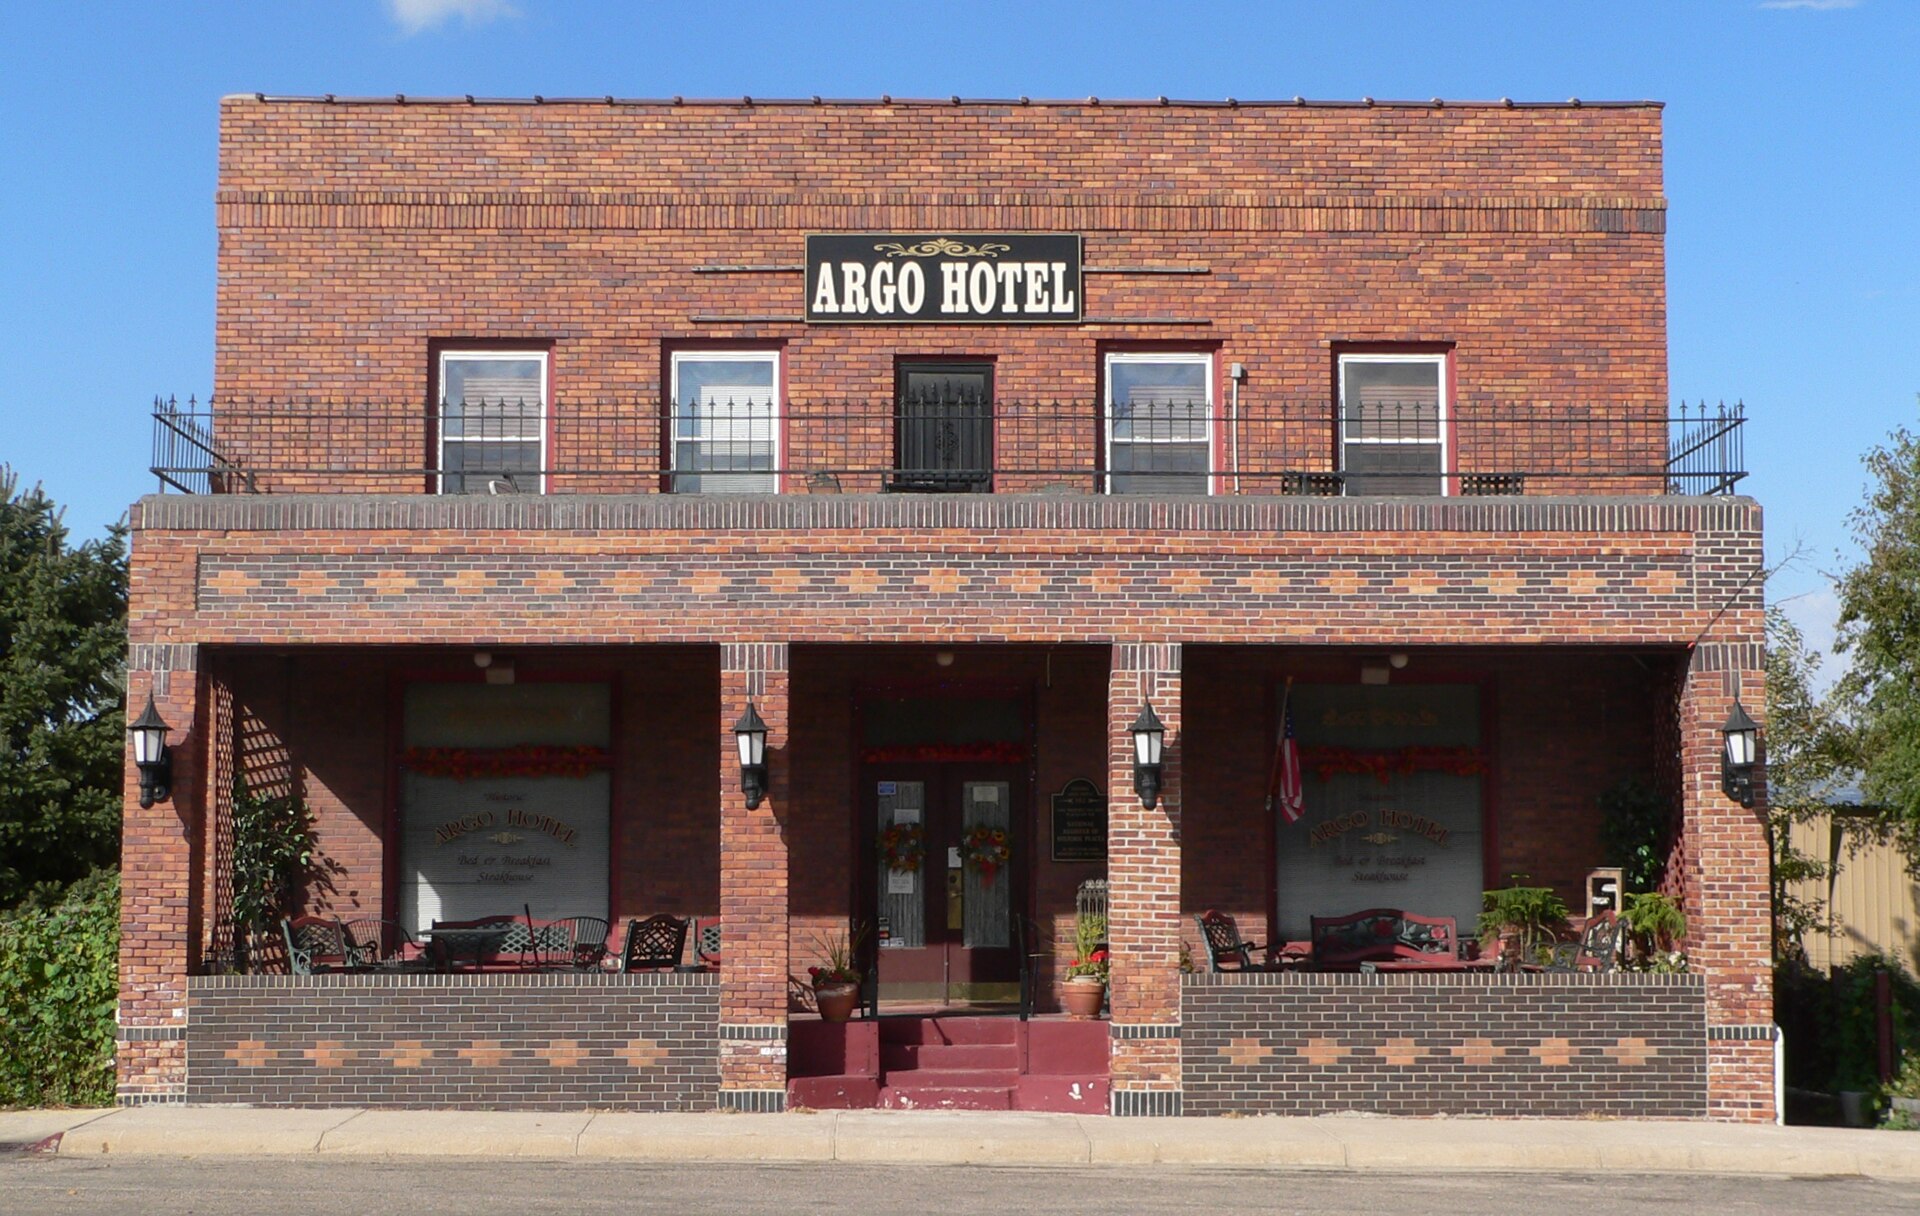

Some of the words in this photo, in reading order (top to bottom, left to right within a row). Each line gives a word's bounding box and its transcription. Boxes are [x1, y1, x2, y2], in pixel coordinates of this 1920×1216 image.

[812, 261, 925, 314] ARGO
[940, 261, 1075, 314] HOTEL
[434, 810, 496, 848] ARGO
[507, 808, 577, 848] HOTEL
[1310, 809, 1370, 848] ARGO
[1379, 808, 1451, 848] HOTEL
[457, 855, 479, 865] Bed
[477, 871, 535, 883] Steakhouse
[1352, 871, 1409, 883] Steakhouse
